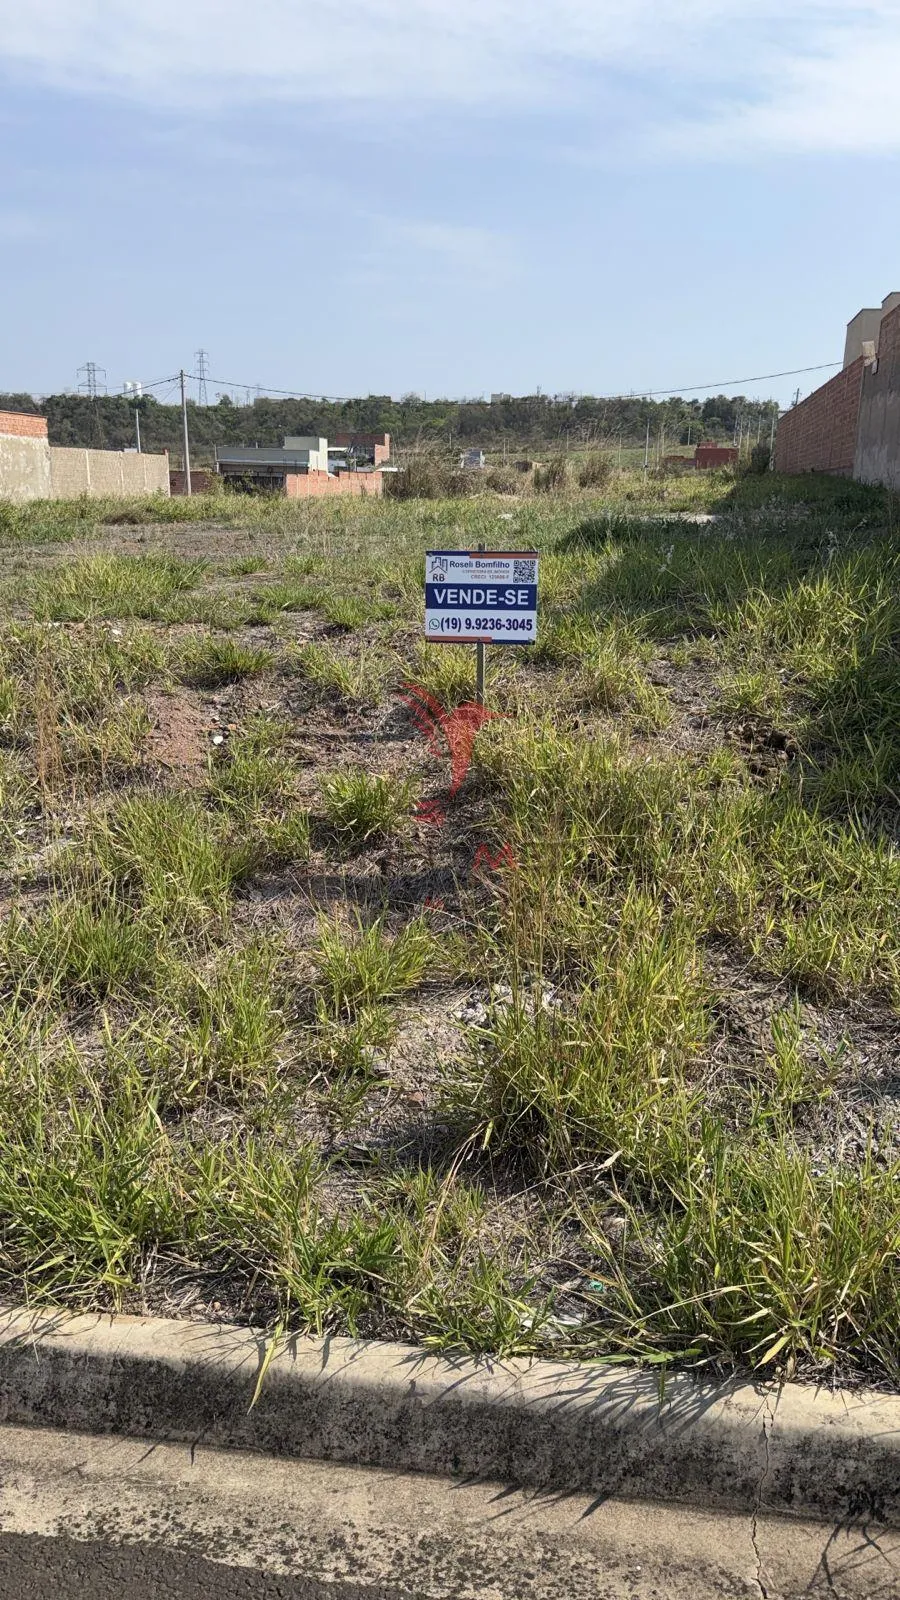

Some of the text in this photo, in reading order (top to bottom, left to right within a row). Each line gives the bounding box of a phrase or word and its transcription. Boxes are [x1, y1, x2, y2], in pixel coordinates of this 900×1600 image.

[475, 561, 510, 569] Bomfilho
[432, 573, 445, 582] RB
[434, 588, 529, 605] VENDE-SE
[441, 617, 533, 633] (19) 9.9236-3045
